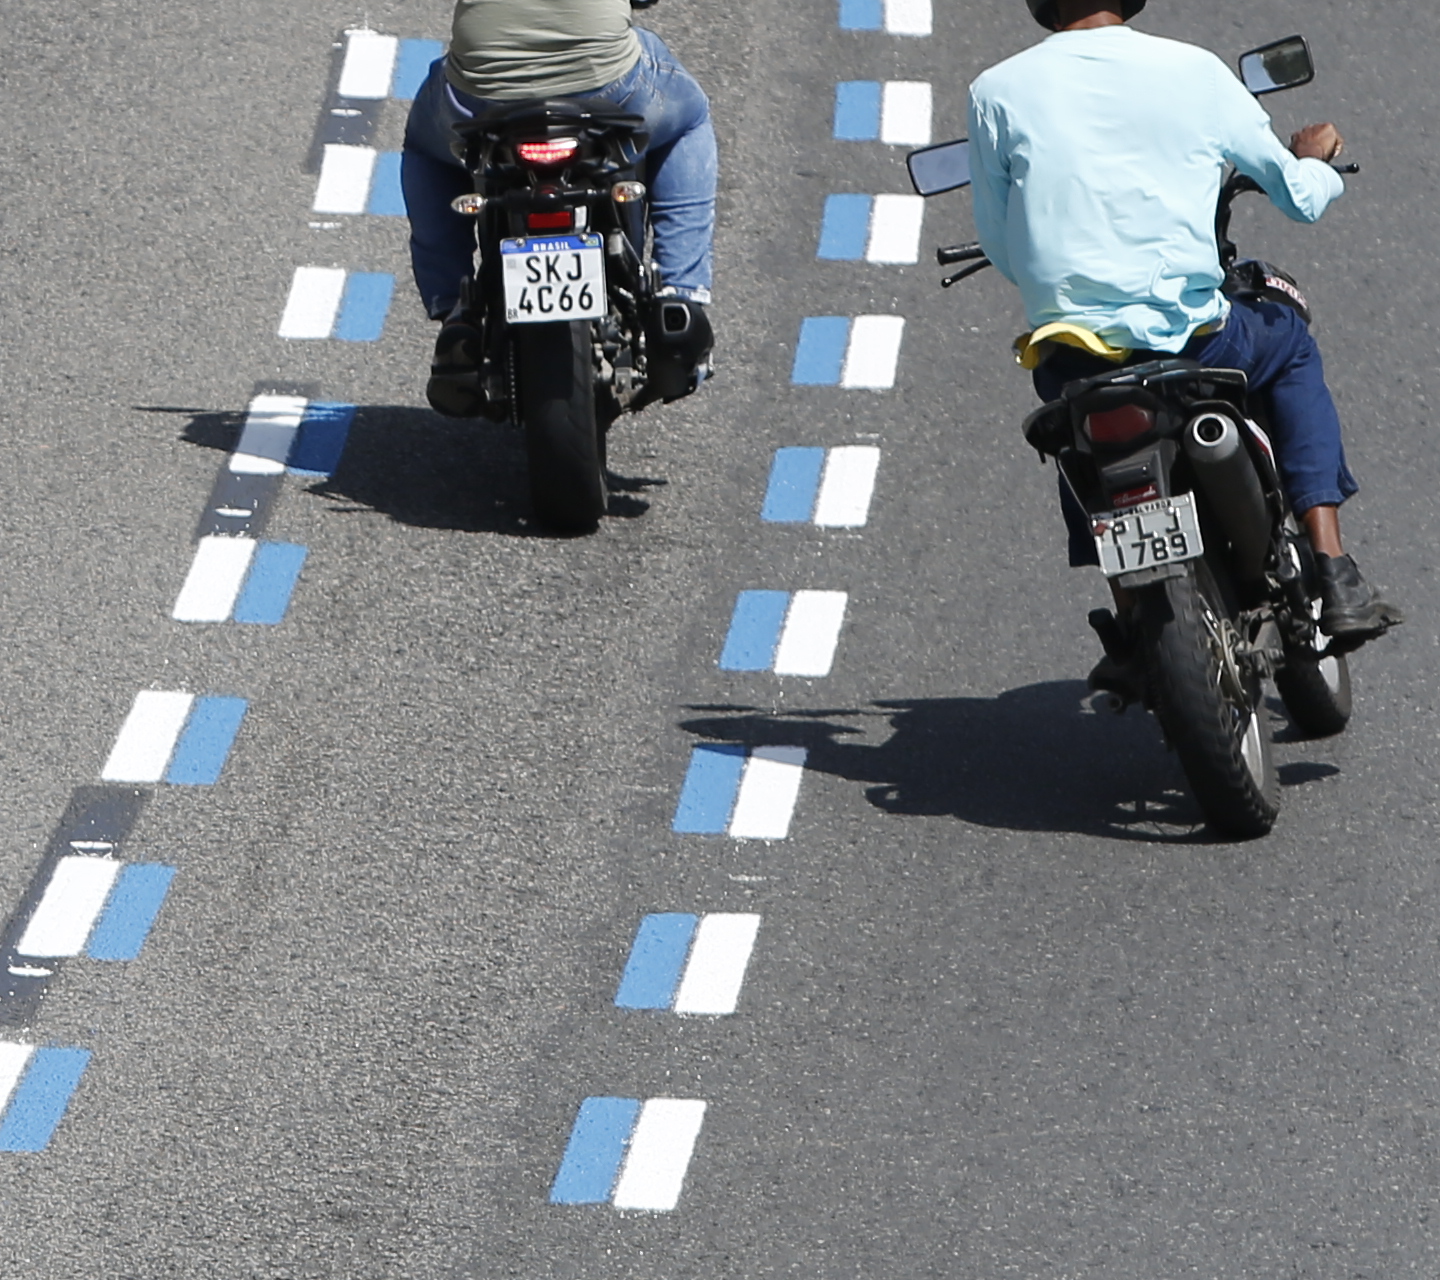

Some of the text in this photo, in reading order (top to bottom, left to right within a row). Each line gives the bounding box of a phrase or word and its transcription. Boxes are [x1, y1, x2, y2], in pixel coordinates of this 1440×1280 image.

[532, 241, 570, 253] BRASIL
[525, 252, 582, 284] SKJ
[518, 282, 593, 315] 4C66
[1116, 532, 1189, 570] 1789
